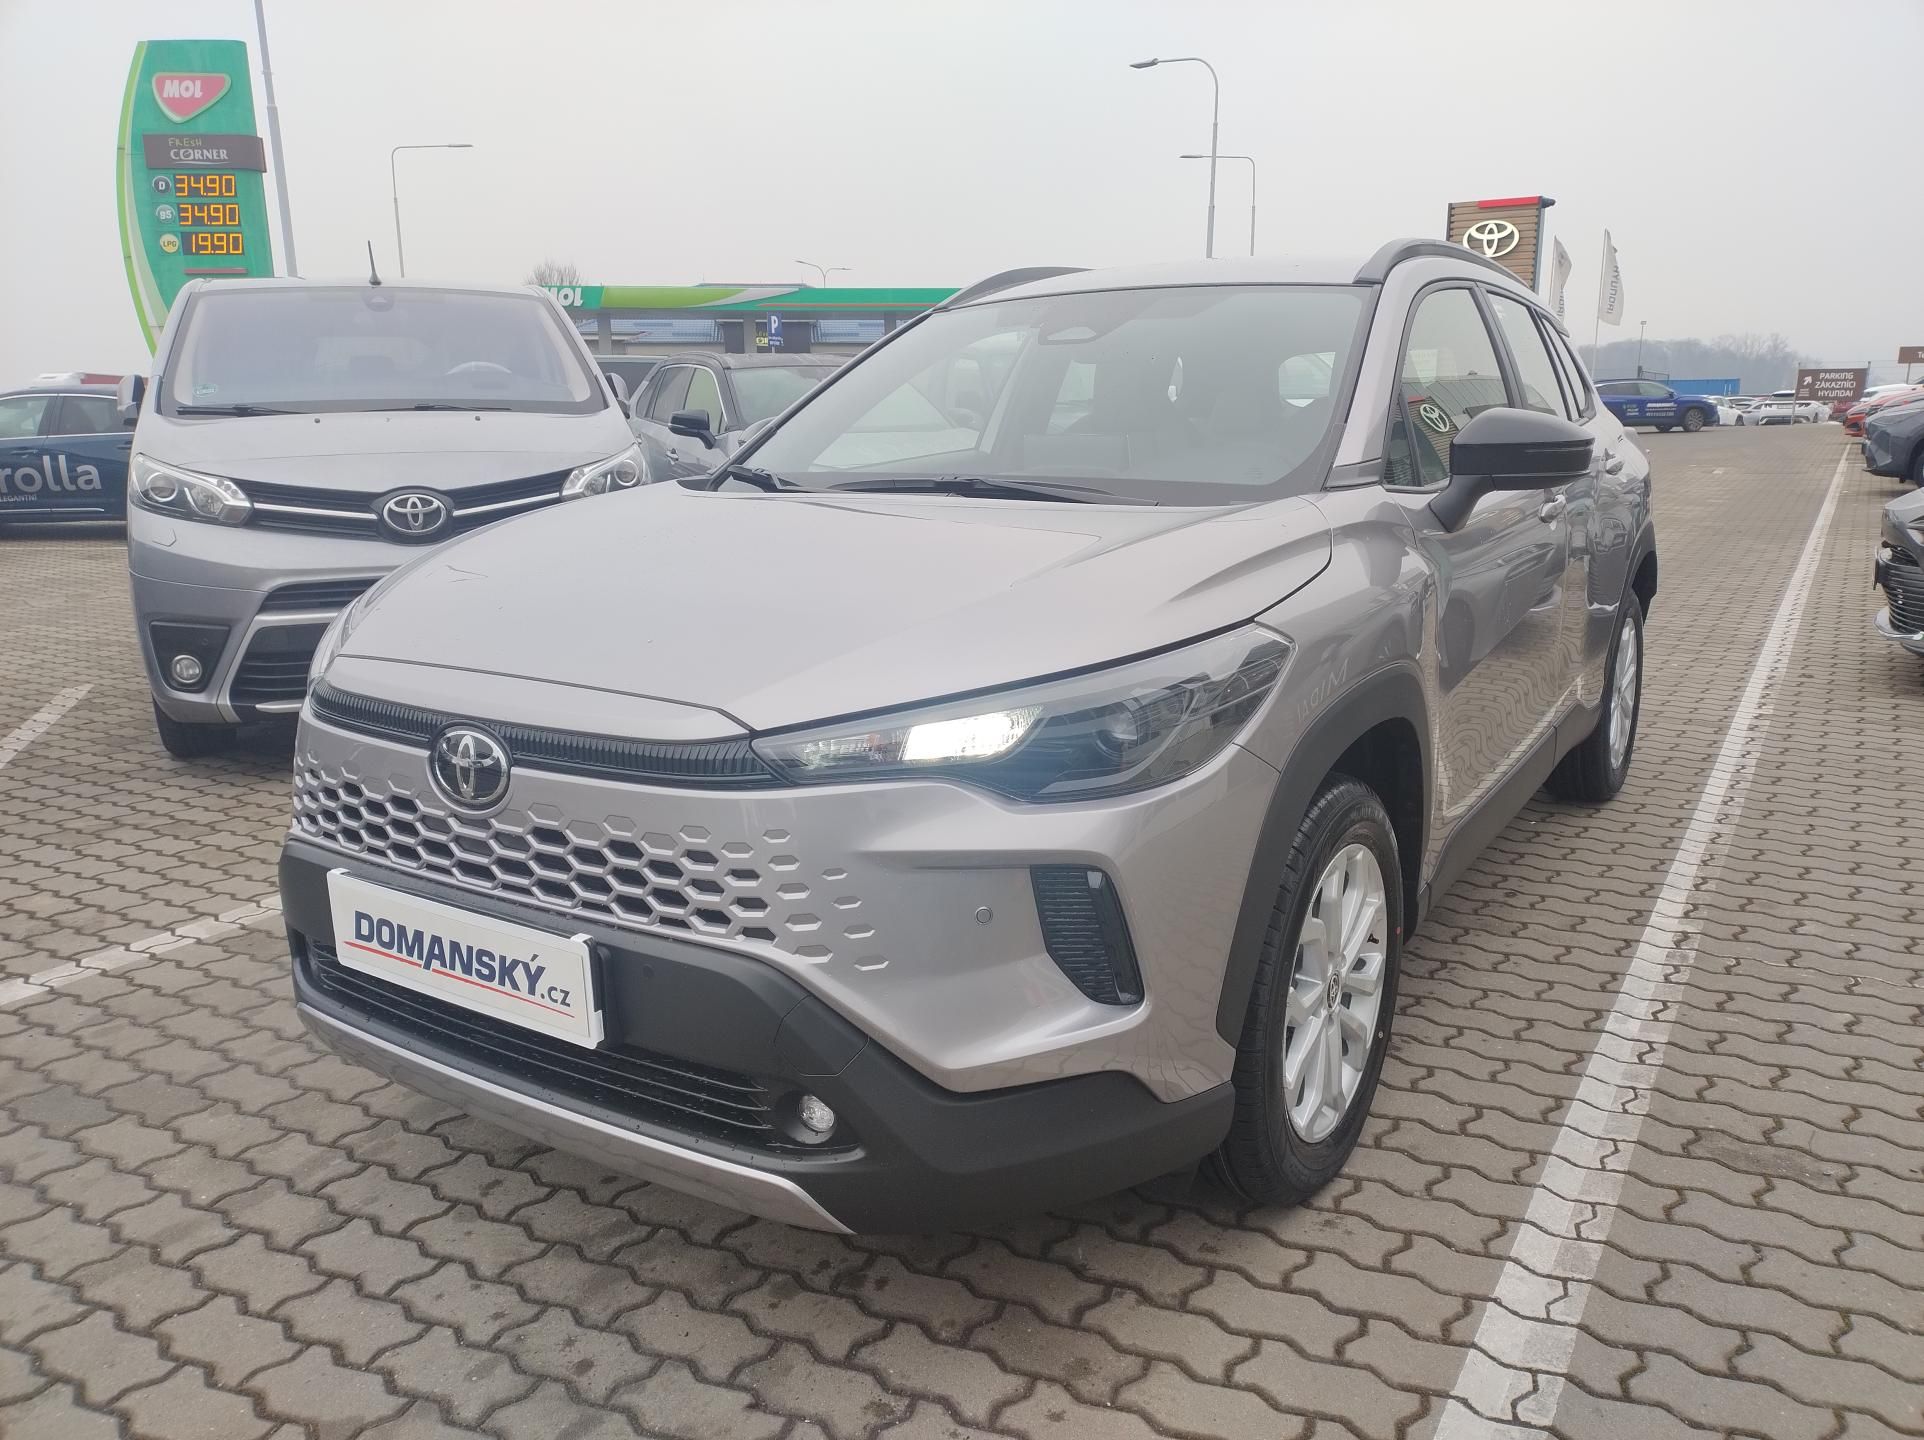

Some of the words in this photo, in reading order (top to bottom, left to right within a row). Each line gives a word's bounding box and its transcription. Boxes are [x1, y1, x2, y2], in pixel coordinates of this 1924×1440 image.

[163, 79, 203, 98] MOL
[170, 148, 229, 160] CORNER
[158, 180, 166, 190] D
[175, 175, 235, 197] 34.90
[159, 210, 172, 220] 95
[179, 204, 239, 226] 34.90
[163, 240, 177, 248] LPG
[191, 233, 243, 255] 19.90
[1820, 372, 1854, 380] PARKING
[1815, 380, 1856, 389] ZÁKAZNÍCI
[1818, 389, 1853, 397] HYUNDAI
